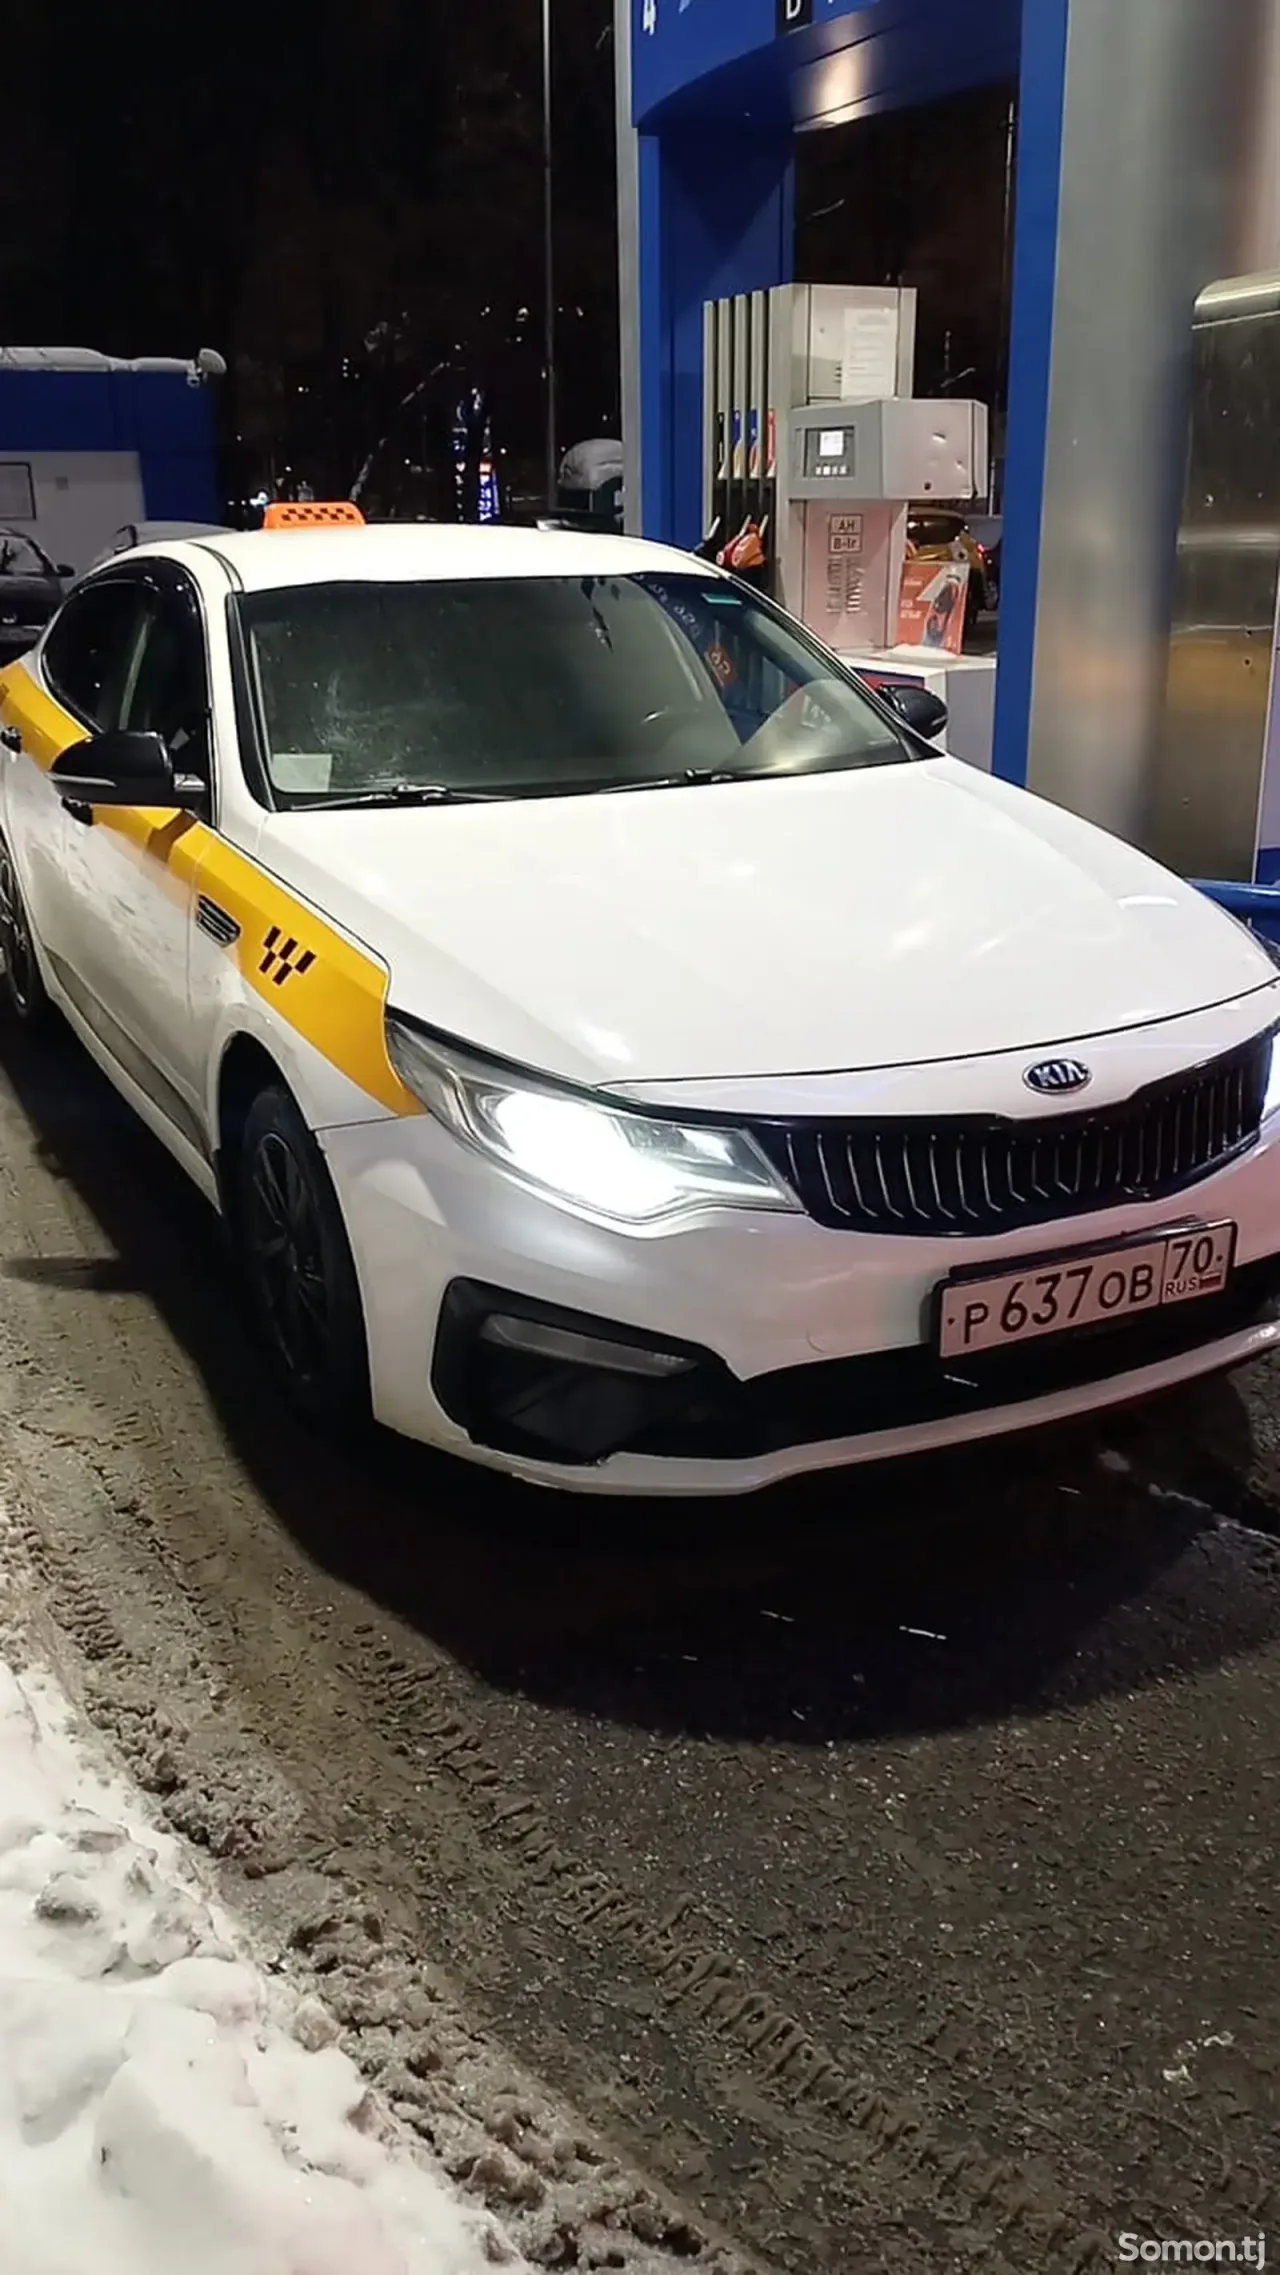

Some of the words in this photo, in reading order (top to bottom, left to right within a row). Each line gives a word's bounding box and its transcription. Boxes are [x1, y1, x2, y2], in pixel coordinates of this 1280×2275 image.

[1034, 1061, 1085, 1087] KIA
[1172, 1236, 1214, 1280] 70
[1165, 1278, 1199, 1297] RUS
